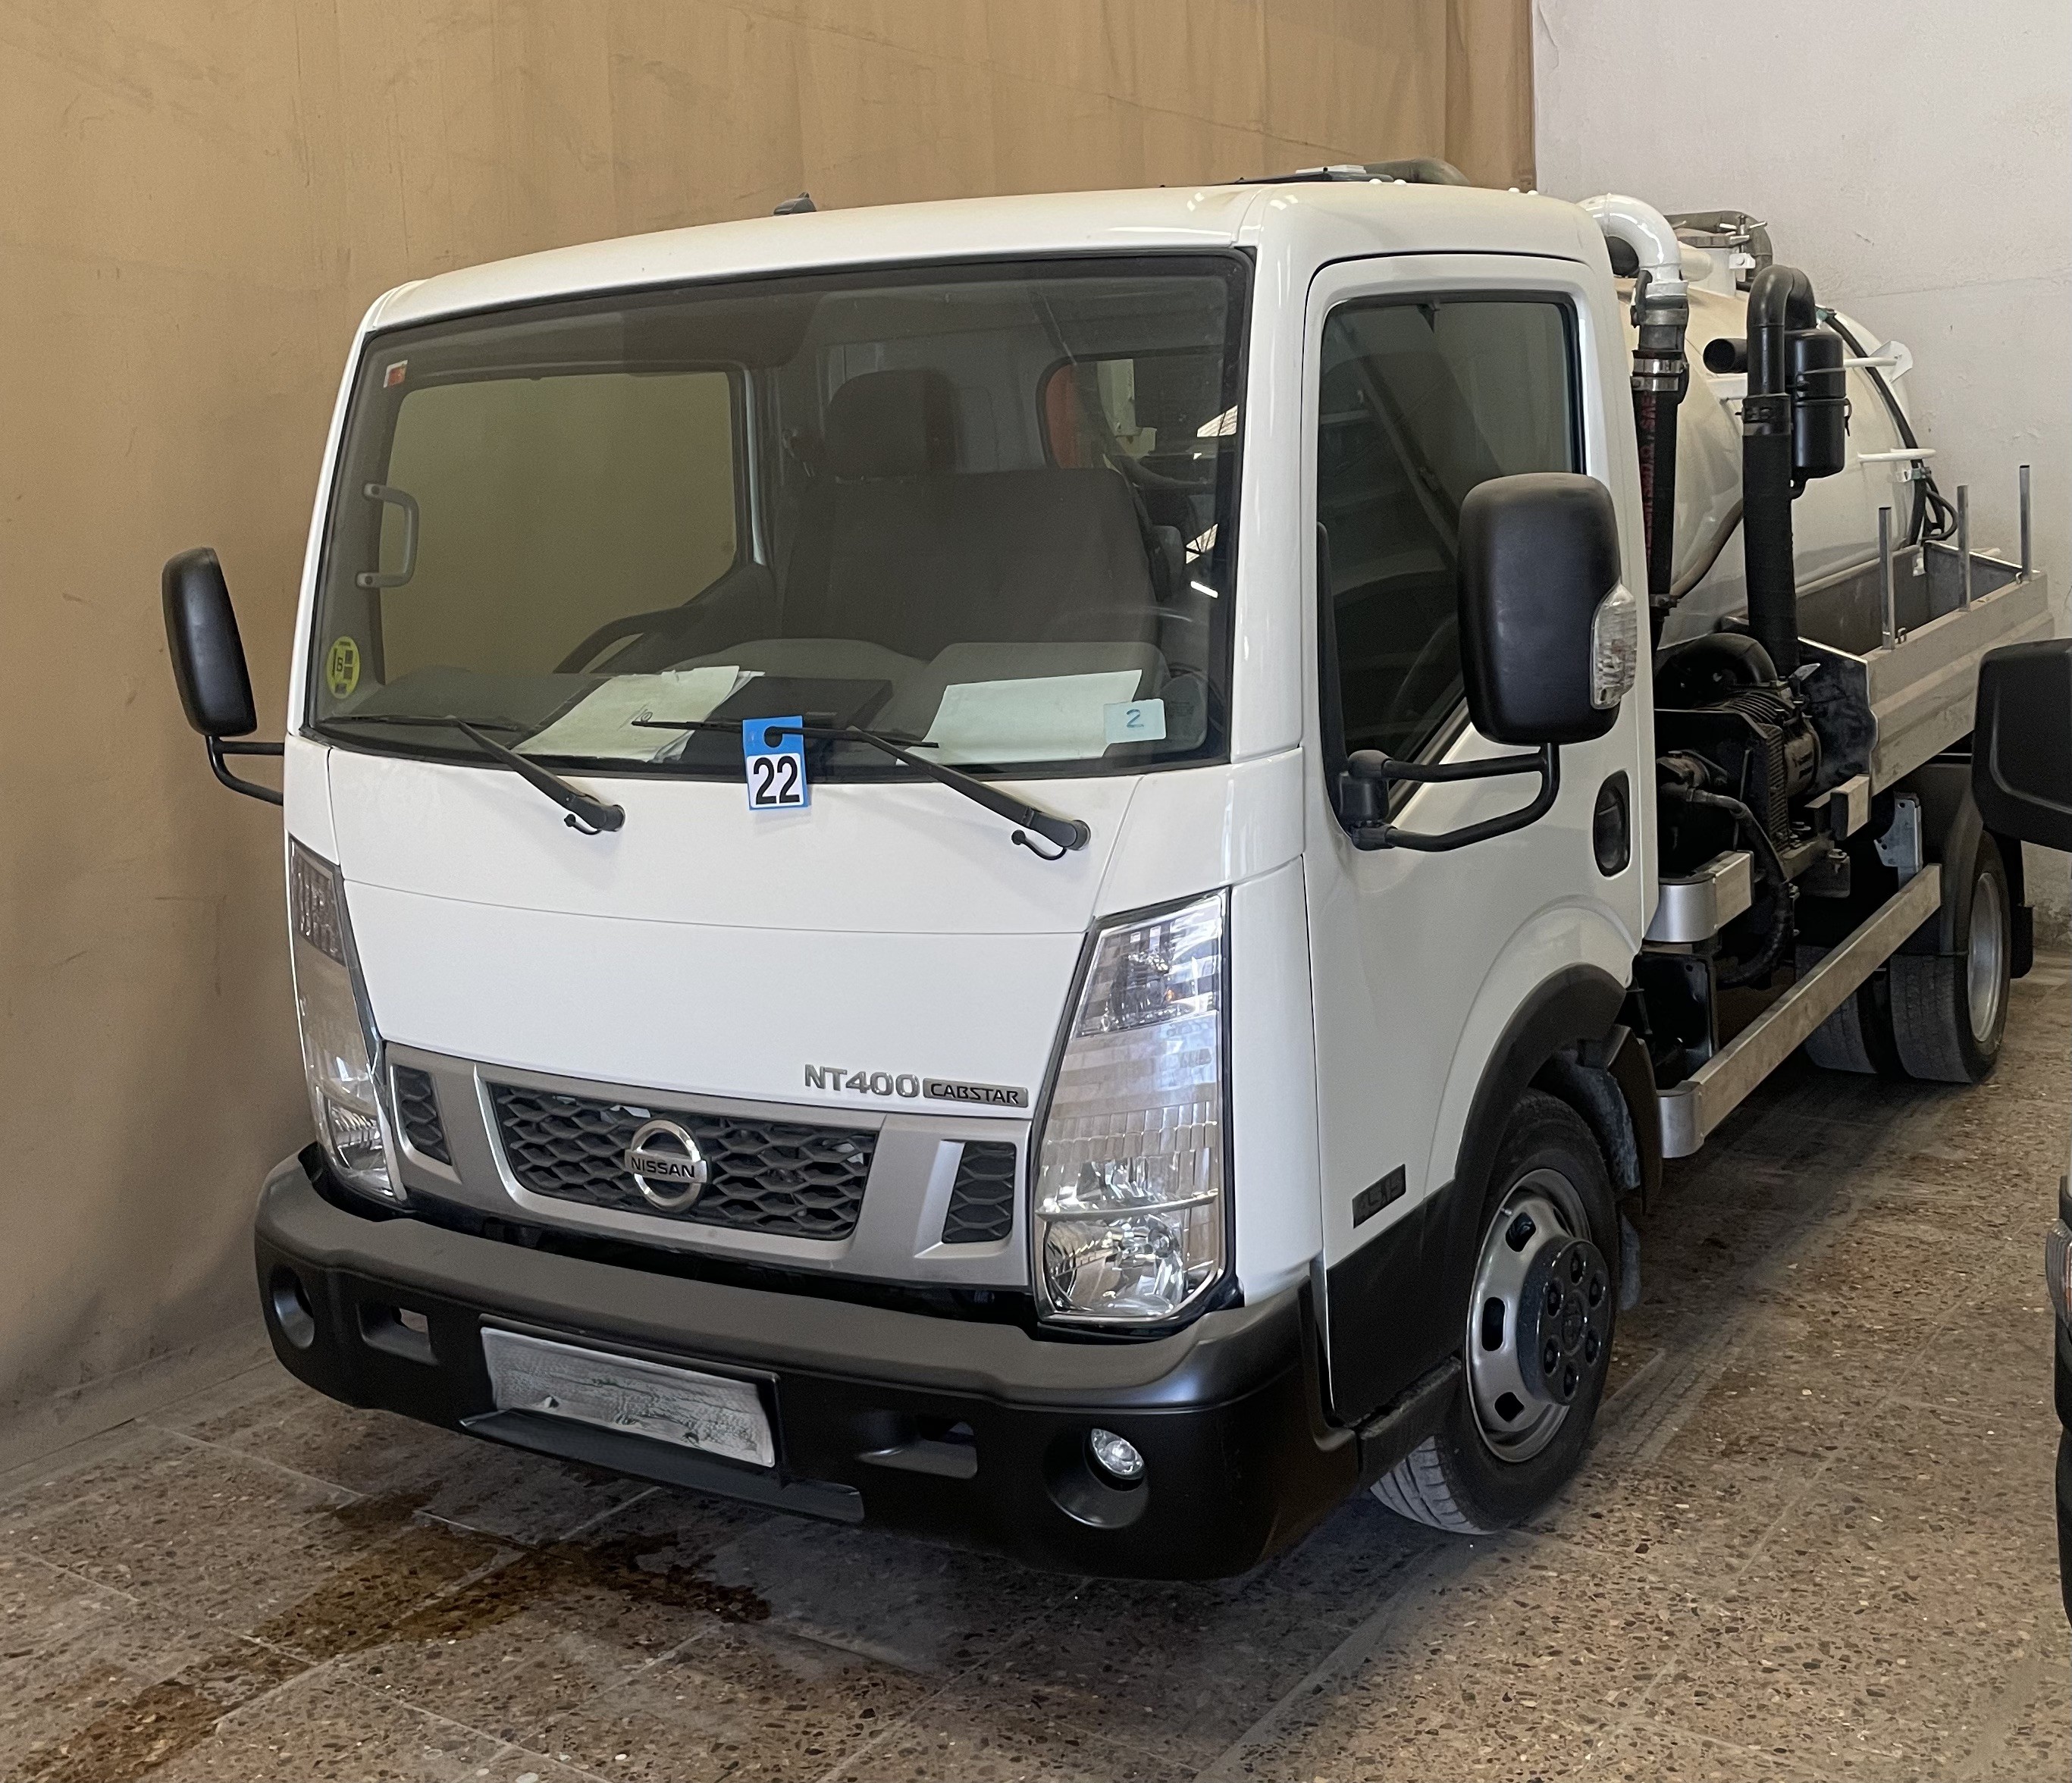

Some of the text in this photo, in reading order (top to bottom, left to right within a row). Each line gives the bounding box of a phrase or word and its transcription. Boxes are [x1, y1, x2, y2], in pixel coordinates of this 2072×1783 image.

[1126, 709, 1144, 729] 2
[753, 755, 801, 805] 22
[804, 1064, 1020, 1105] NT400 CABSTAR
[631, 1156, 696, 1179] NISSAN
